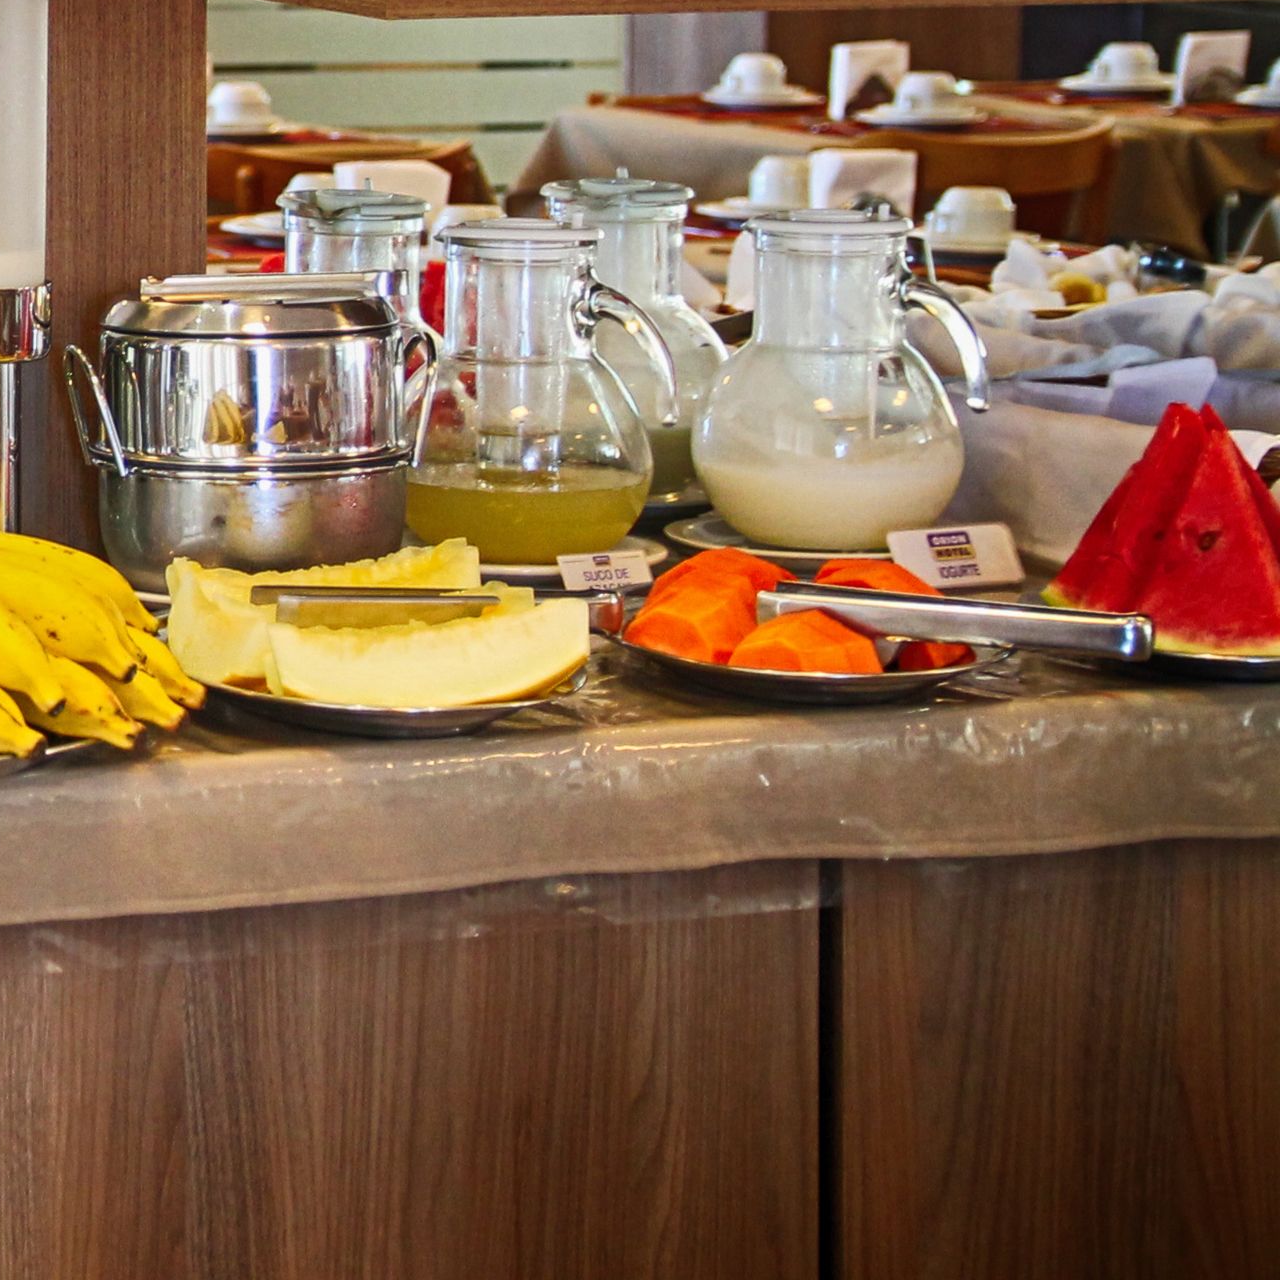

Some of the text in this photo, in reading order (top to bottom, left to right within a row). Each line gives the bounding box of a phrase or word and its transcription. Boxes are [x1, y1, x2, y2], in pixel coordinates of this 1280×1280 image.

[583, 568, 630, 582] SUCO DE
[939, 563, 981, 578] IOGURTE
